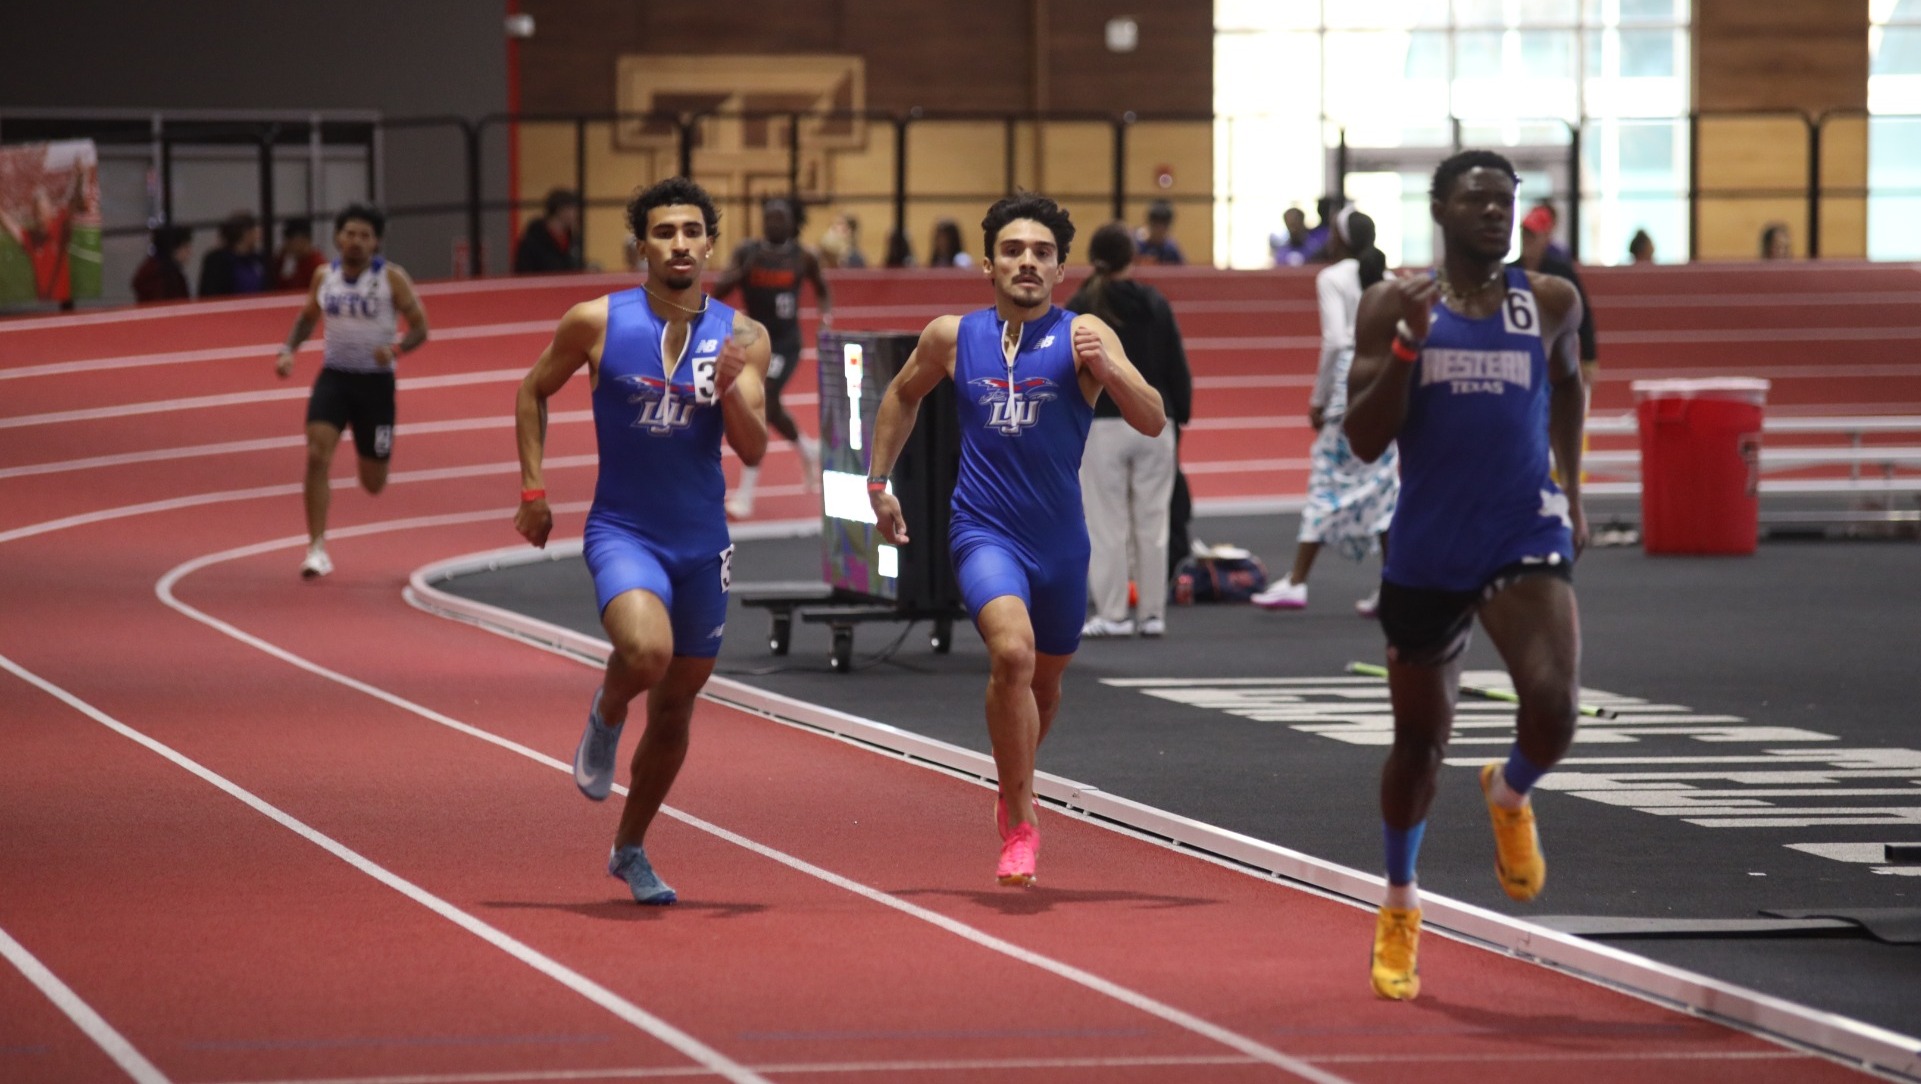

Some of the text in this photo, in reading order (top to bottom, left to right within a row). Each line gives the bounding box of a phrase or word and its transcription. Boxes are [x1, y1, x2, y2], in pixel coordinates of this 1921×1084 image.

[1508, 292, 1532, 330] 6
[697, 360, 716, 398] 3
[1420, 348, 1532, 391] WESTERN
[1450, 380, 1504, 395] TEXAS
